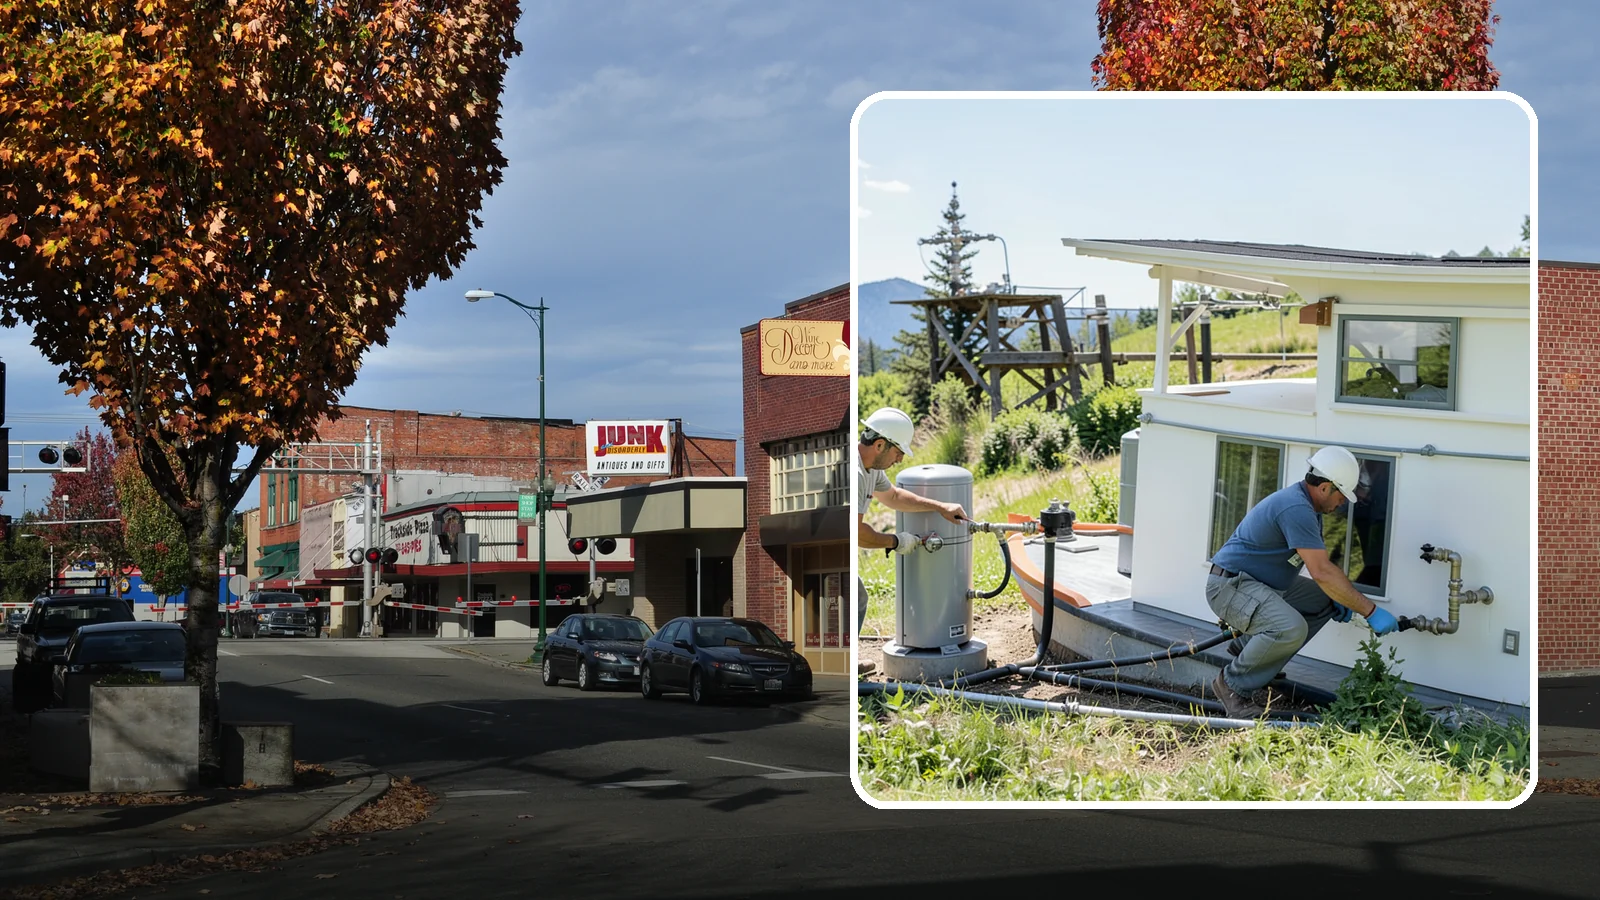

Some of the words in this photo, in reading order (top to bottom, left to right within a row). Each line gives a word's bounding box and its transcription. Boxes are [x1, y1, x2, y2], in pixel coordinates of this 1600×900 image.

[595, 425, 665, 457] JUNK
[607, 446, 646, 454] DISORDERLY
[597, 461, 628, 470] ANTIQUES
[631, 461, 644, 470] AND
[647, 460, 666, 469] GIFTS
[414, 519, 430, 535] Pizza
